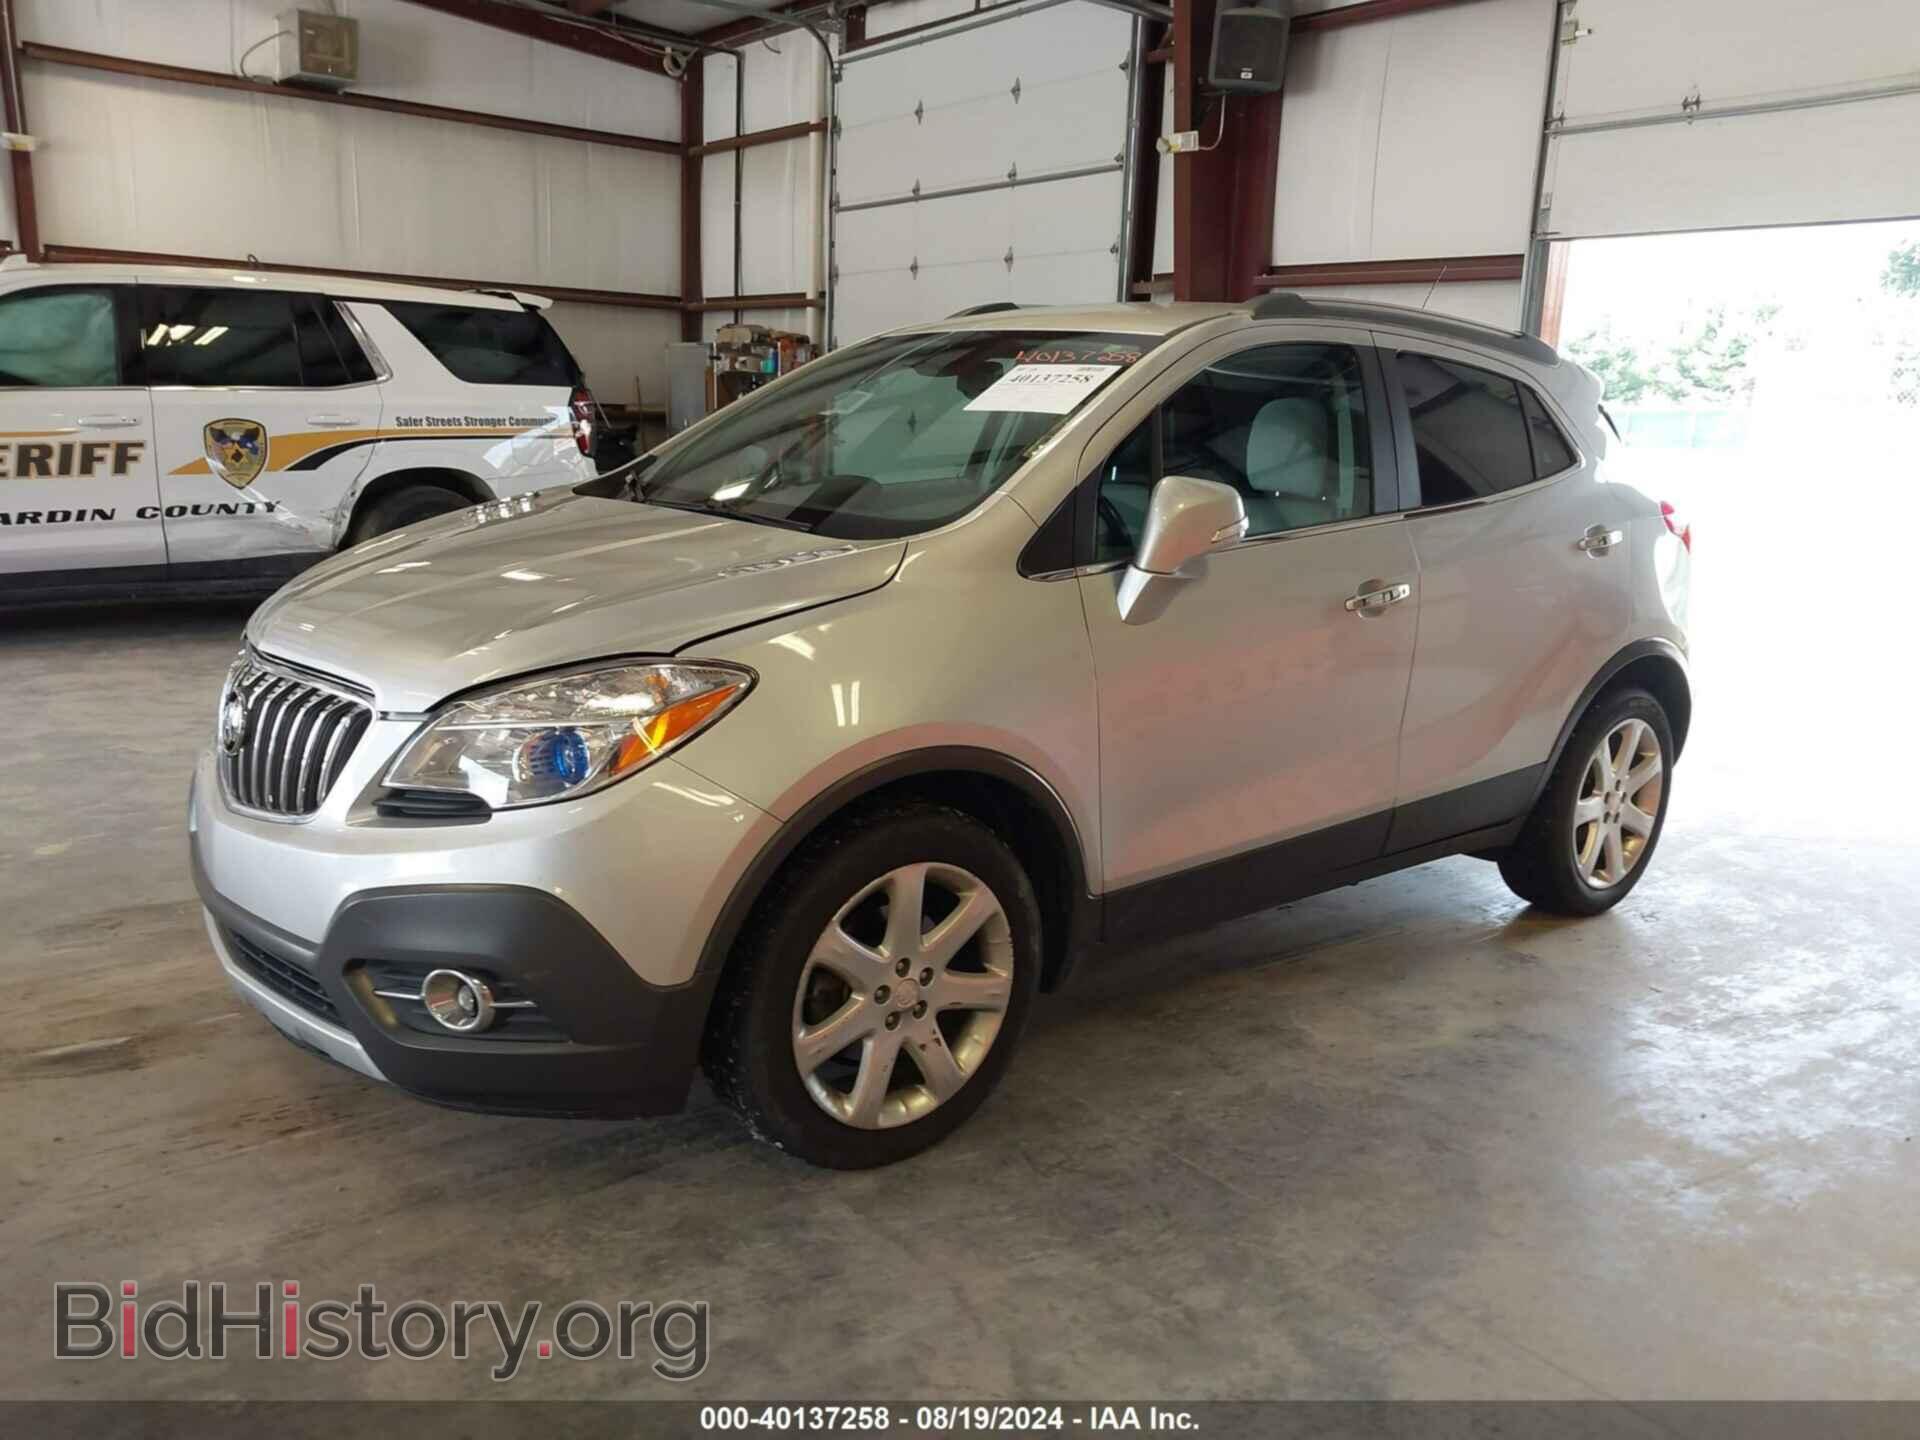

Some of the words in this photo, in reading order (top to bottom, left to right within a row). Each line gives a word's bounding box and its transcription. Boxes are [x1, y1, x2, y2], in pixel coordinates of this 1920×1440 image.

[395, 416, 424, 428] Safer
[425, 415, 463, 427] Streets
[463, 415, 507, 428] Stronger
[136, 501, 280, 520] COUNTY
